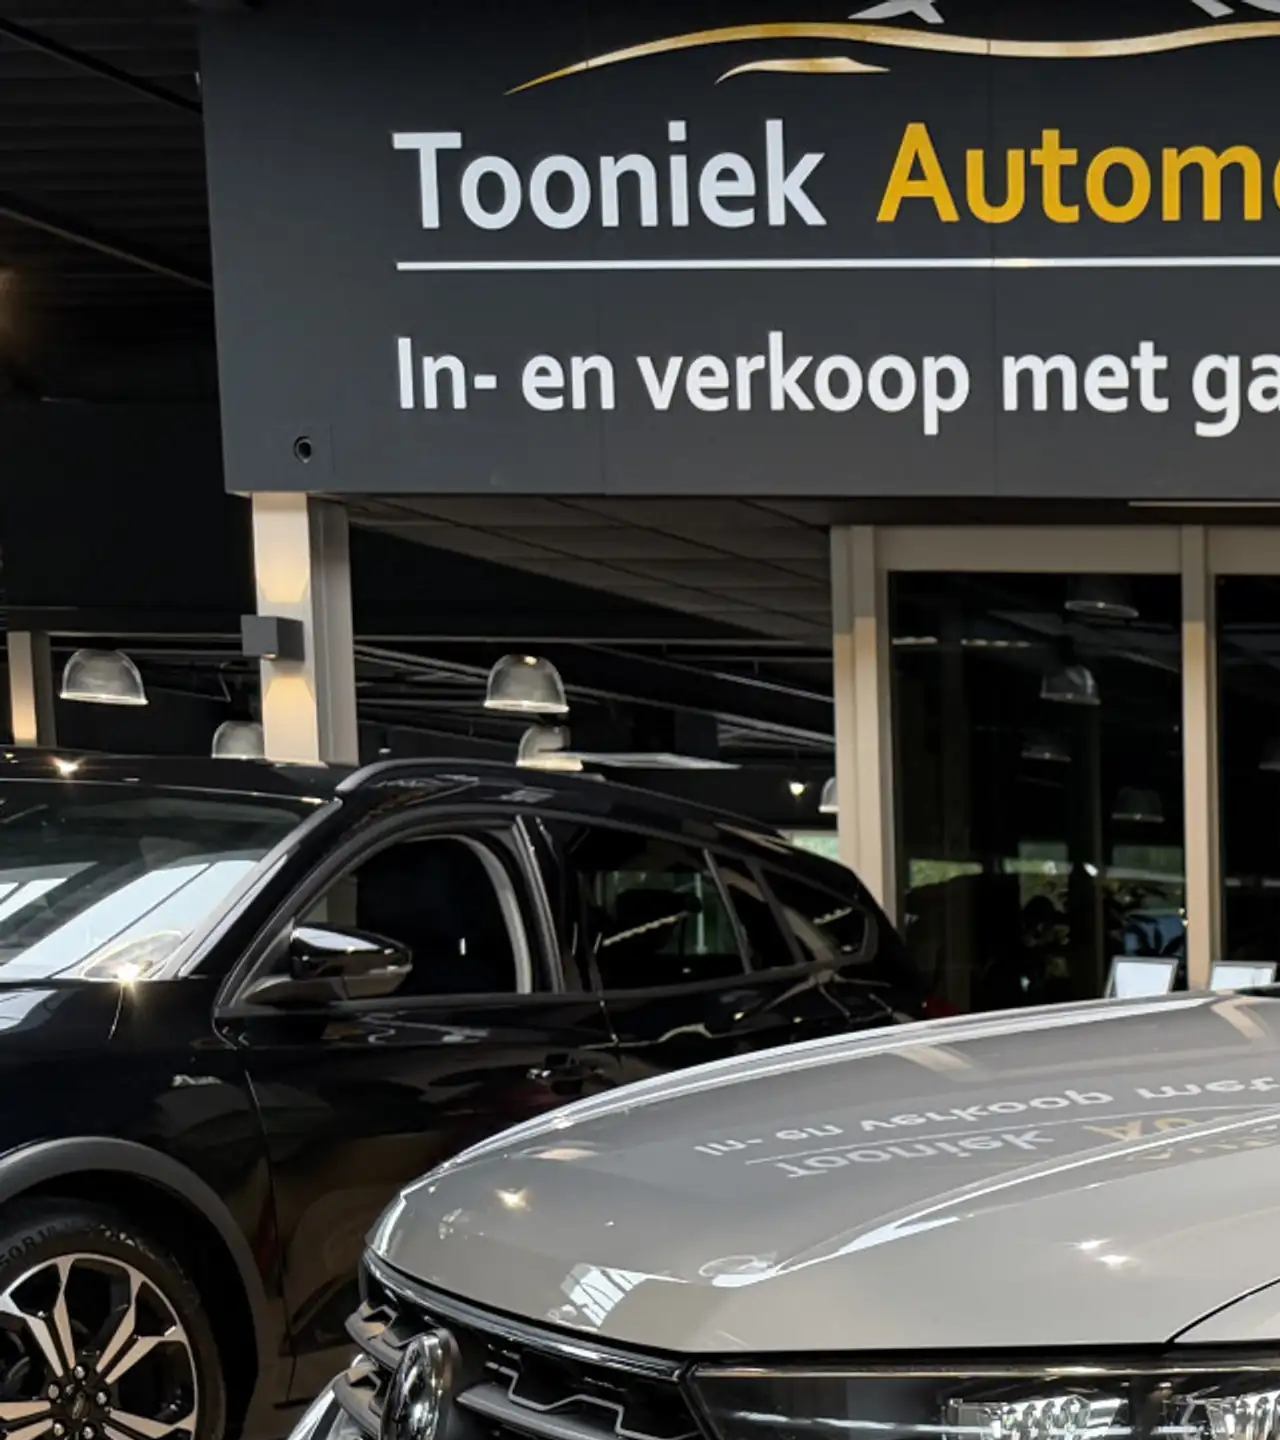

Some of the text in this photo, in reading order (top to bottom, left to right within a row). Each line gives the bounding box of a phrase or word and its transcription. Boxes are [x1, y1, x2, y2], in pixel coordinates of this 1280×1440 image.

[392, 119, 827, 230] Tooniek
[397, 337, 497, 410] In-
[521, 354, 615, 411] en
[636, 330, 970, 436] verkoop
[1002, 341, 1169, 413] met
